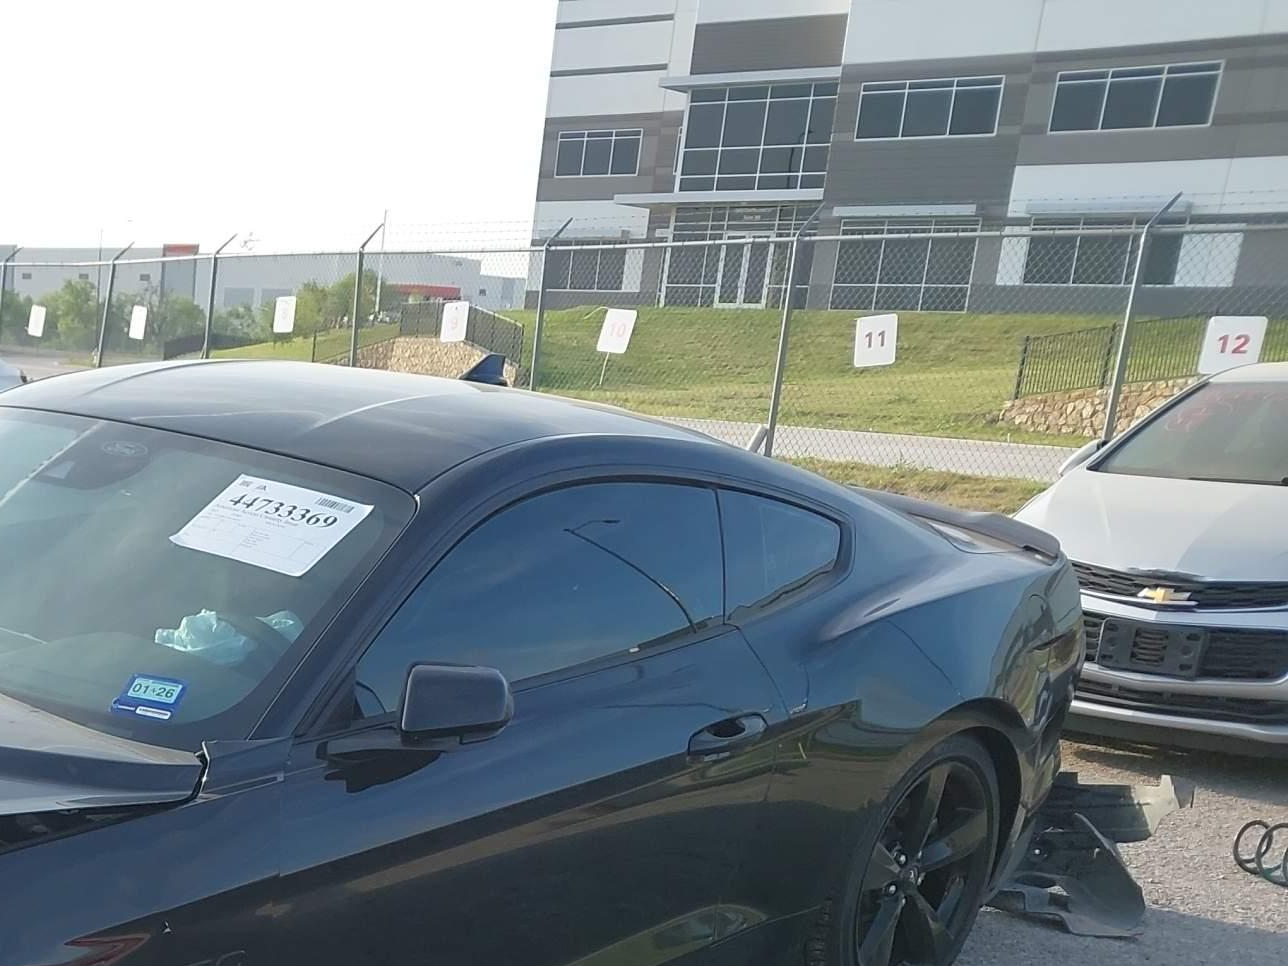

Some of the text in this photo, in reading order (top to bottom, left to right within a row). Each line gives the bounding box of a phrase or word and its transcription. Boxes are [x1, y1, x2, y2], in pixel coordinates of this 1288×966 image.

[864, 330, 886, 349] 11
[1217, 334, 1251, 354] 12
[229, 493, 339, 529] 44733369
